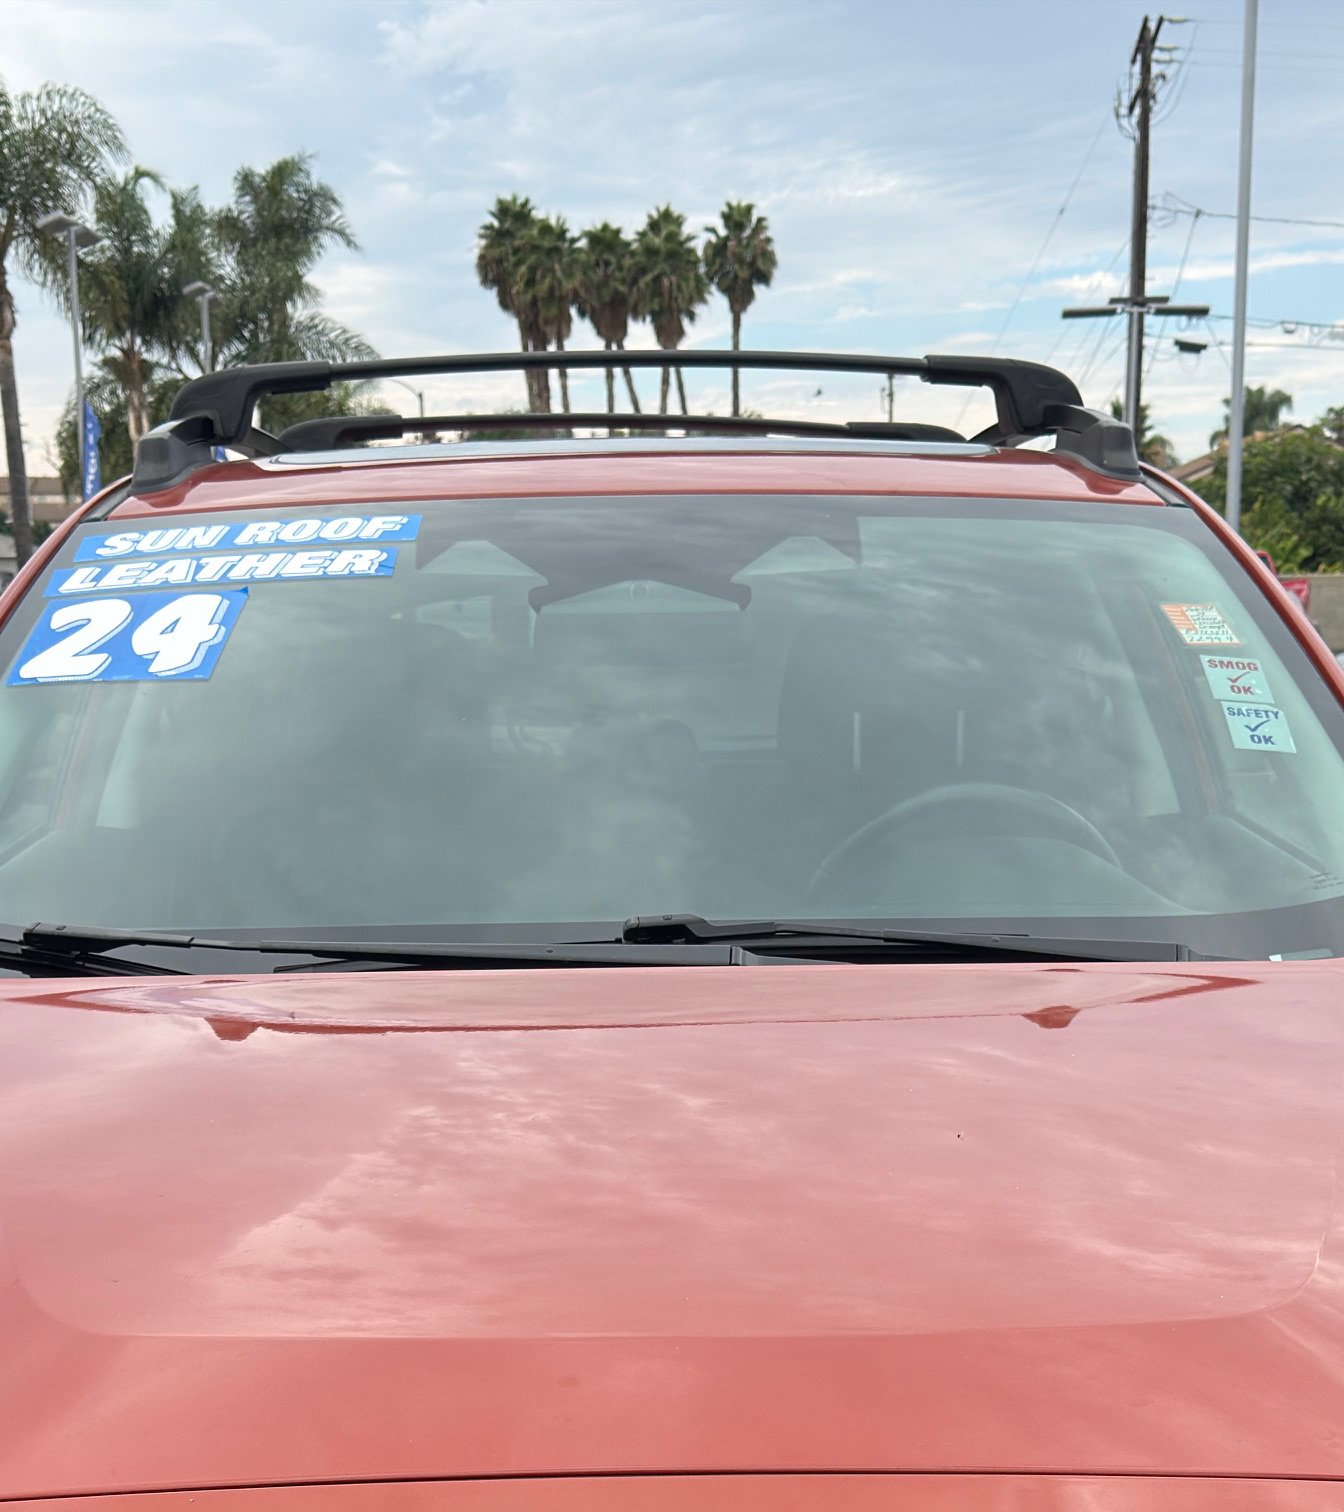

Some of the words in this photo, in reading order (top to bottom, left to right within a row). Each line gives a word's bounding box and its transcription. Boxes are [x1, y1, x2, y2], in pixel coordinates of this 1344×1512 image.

[95, 524, 231, 557] SUN
[233, 515, 409, 545] ROOF
[58, 548, 389, 594] LEATHER
[19, 593, 231, 683] 24
[1207, 658, 1260, 672] SMOG
[1230, 684, 1255, 695] OK
[1226, 706, 1280, 720] SAFETY
[1250, 734, 1276, 746] OK
